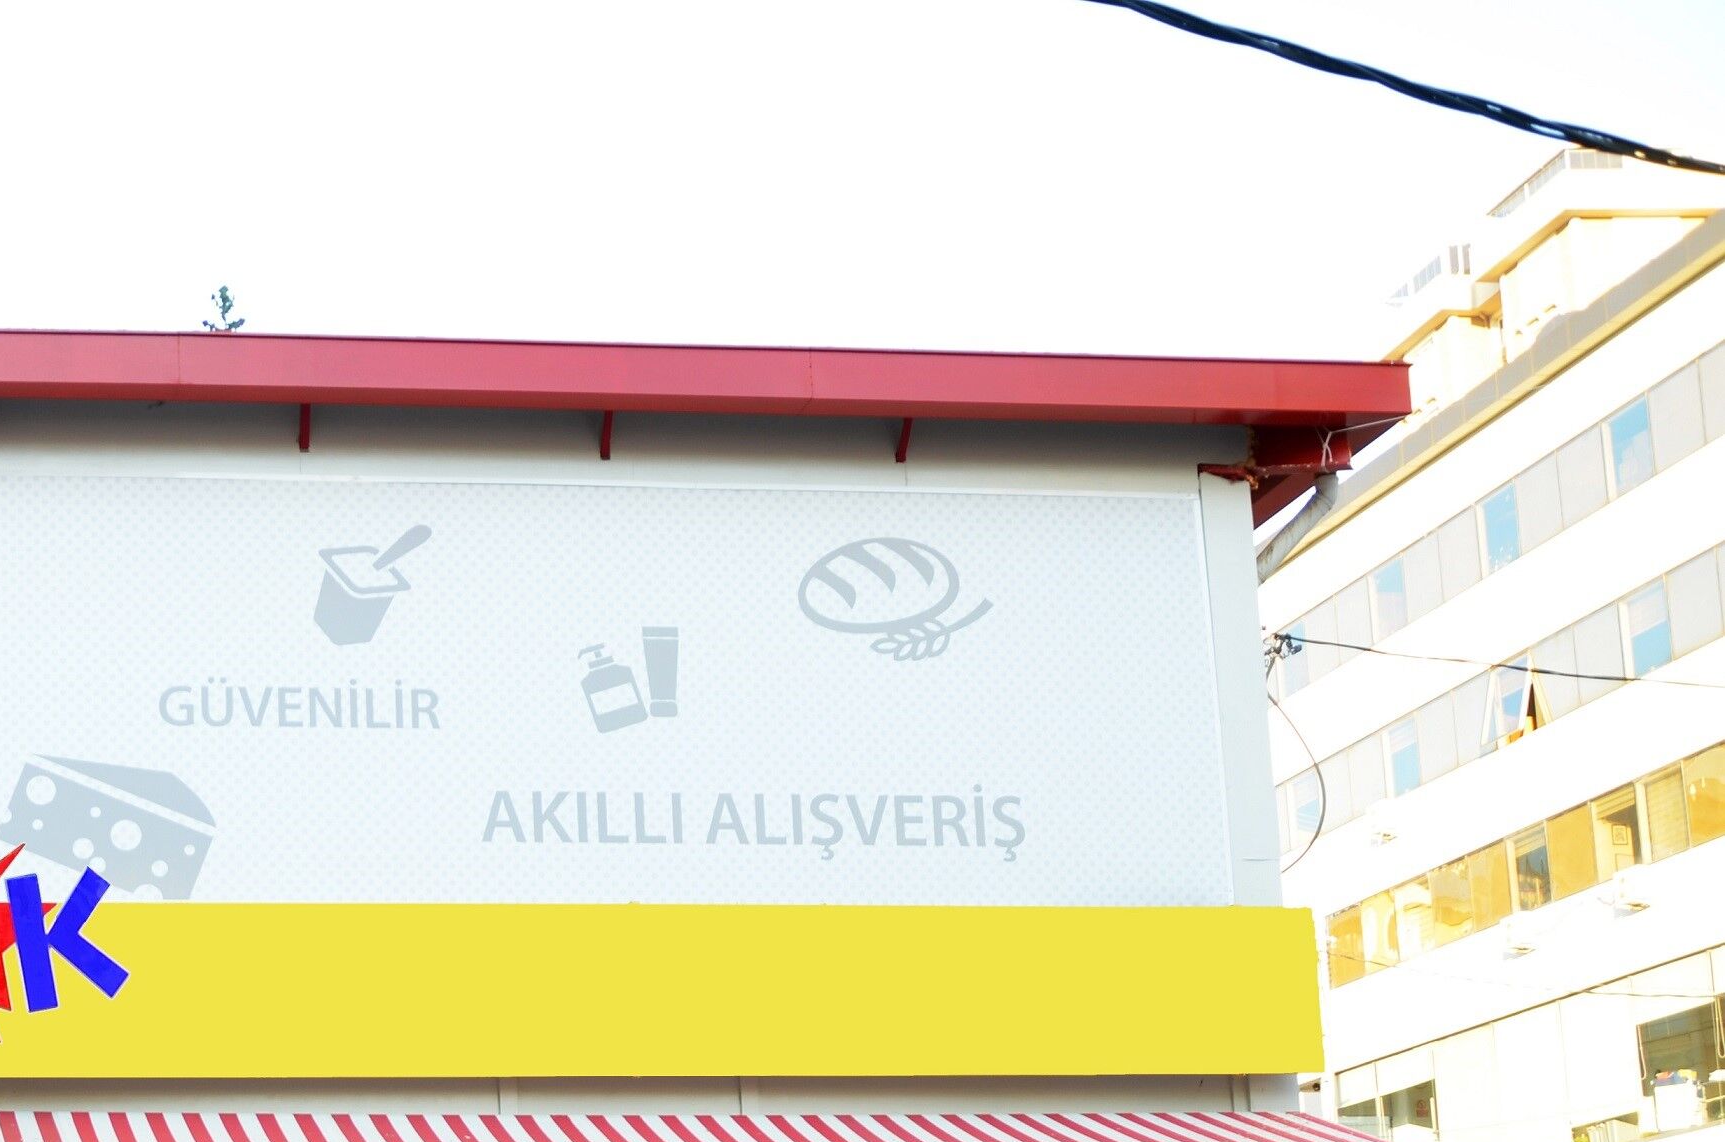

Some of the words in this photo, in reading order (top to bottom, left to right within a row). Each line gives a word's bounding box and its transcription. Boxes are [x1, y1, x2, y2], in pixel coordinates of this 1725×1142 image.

[157, 676, 442, 731] GÜVENİLİR
[481, 789, 686, 845] AKILLI
[705, 783, 1028, 862] ALIŞVERİŞ
